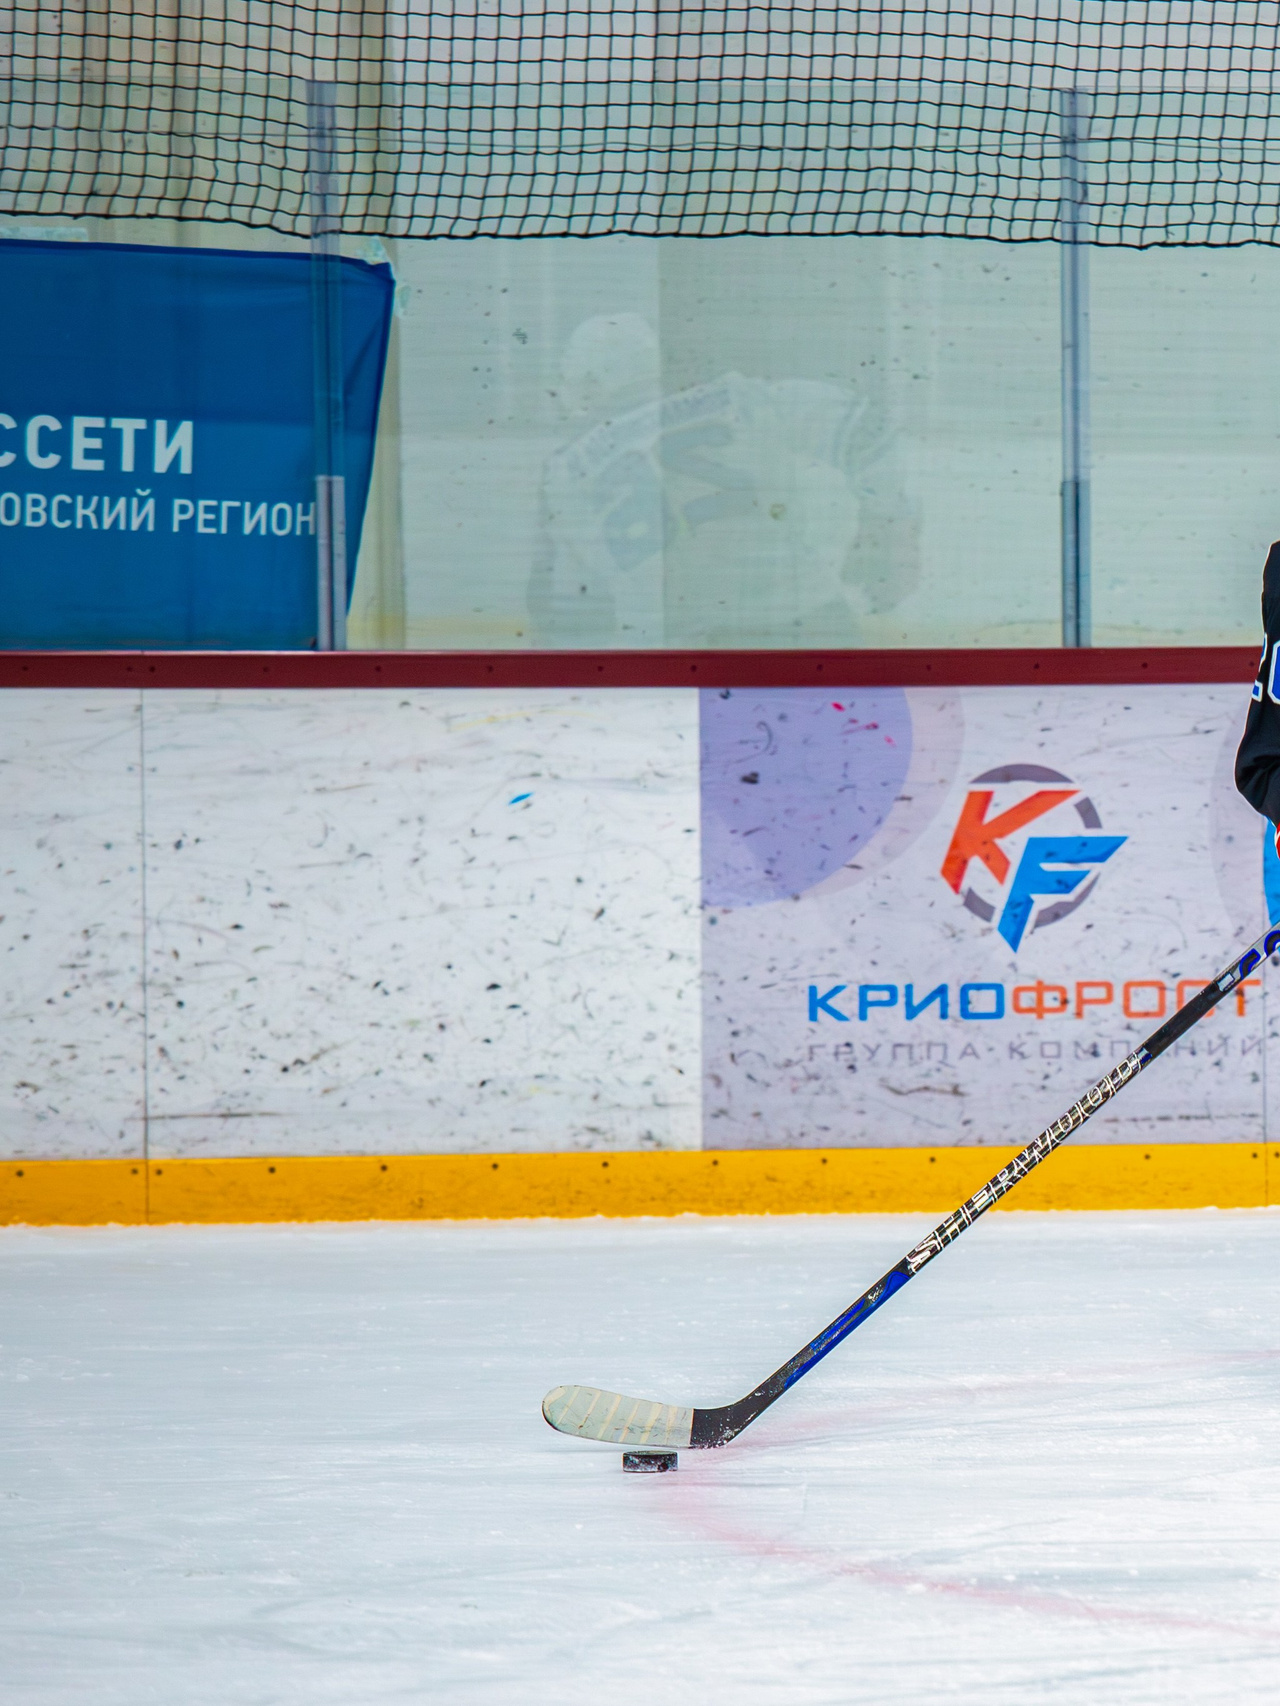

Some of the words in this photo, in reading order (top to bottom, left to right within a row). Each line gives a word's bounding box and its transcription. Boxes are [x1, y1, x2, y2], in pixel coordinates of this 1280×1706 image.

[172, 498, 316, 536] РЕГИОН
[808, 1042, 981, 1063] ГРУППА
[1008, 1034, 1262, 1061] КОМПНИЙ
